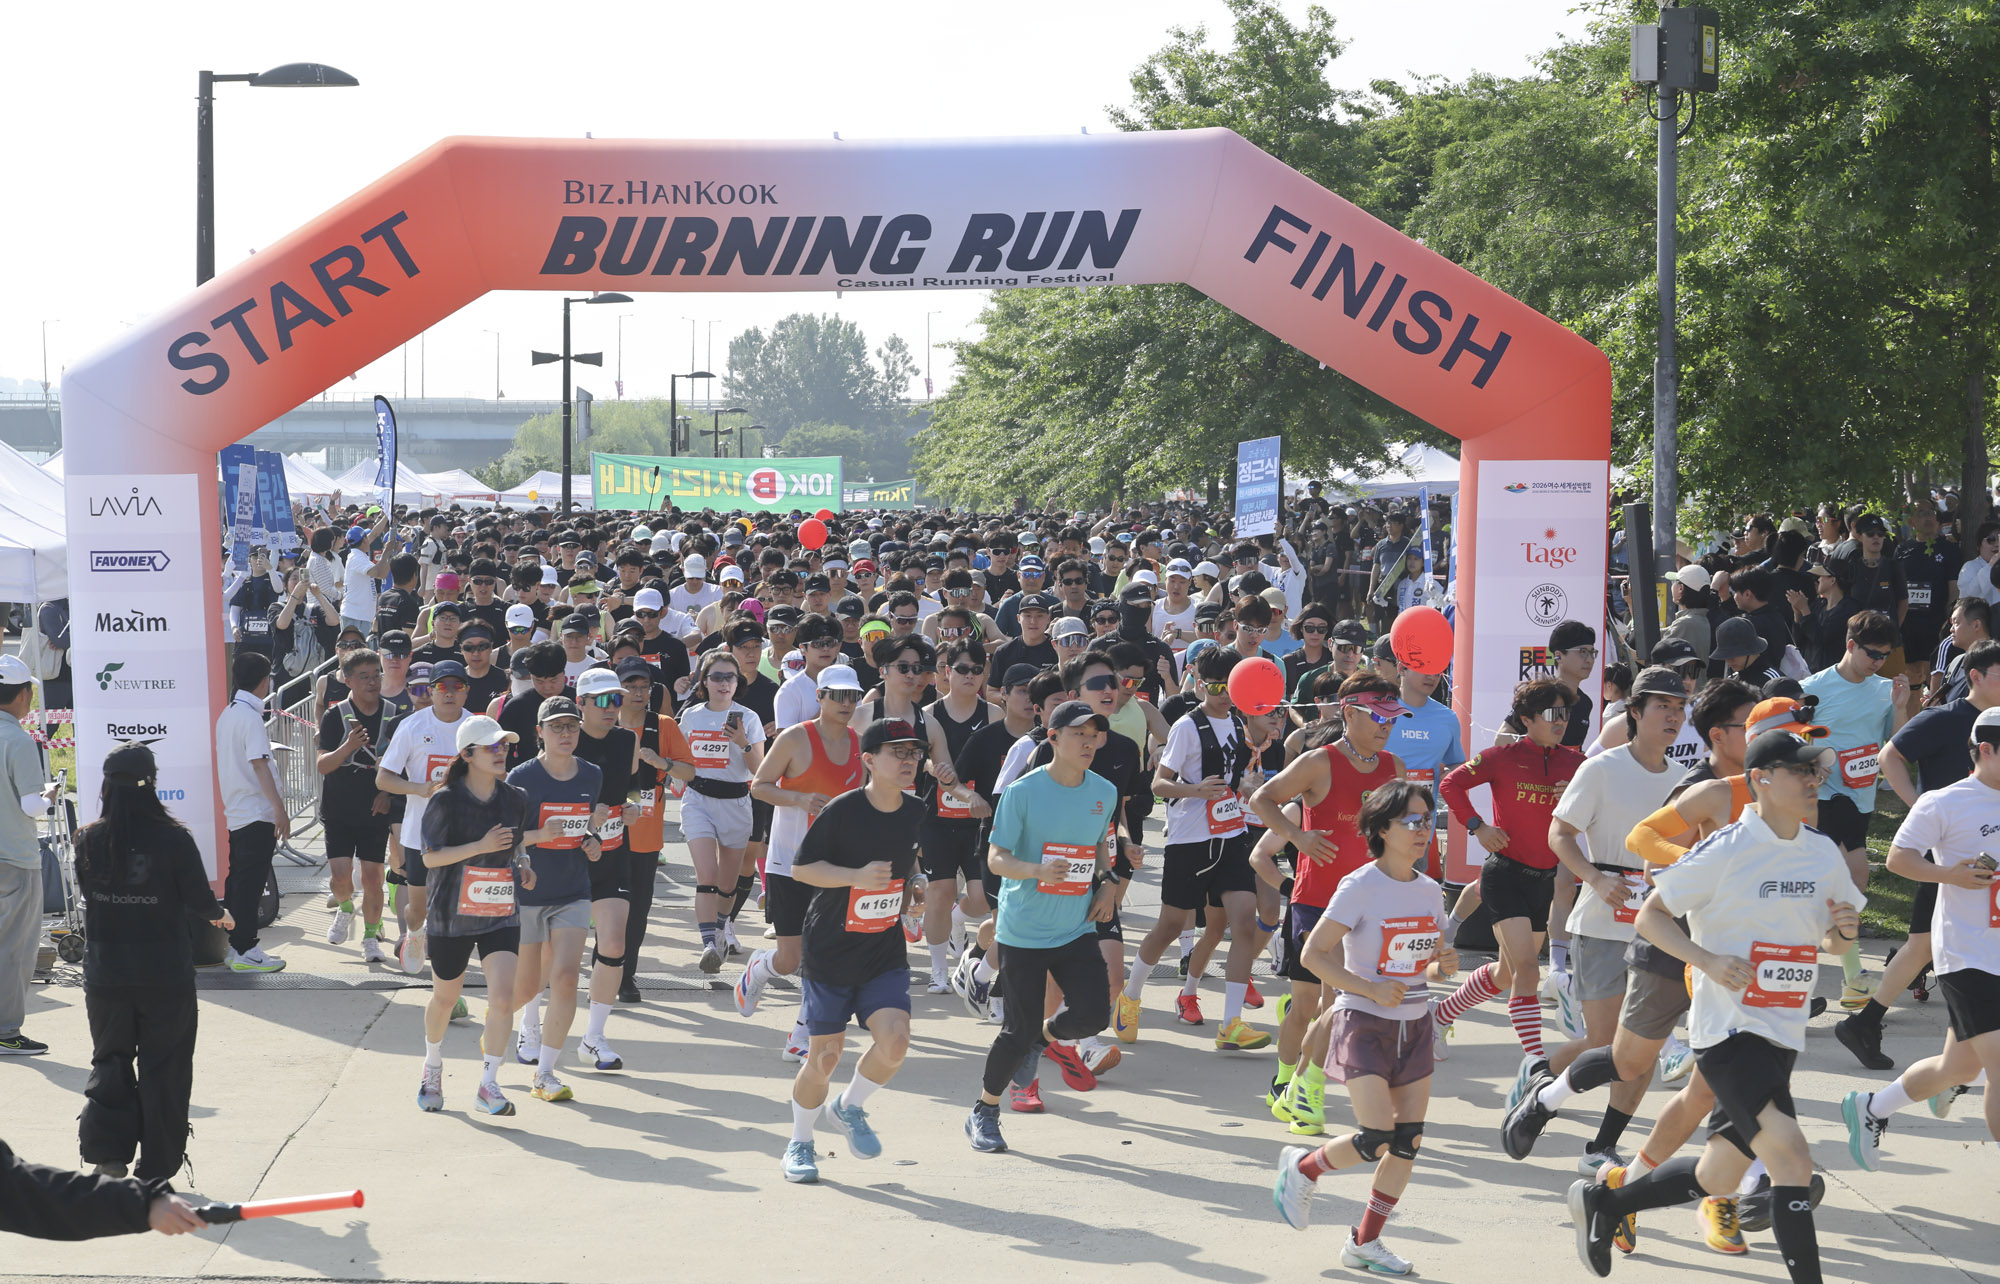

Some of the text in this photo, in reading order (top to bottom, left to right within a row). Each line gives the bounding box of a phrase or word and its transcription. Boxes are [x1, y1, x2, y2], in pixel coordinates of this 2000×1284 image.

[539, 208, 1142, 276] BURNING RUN
[837, 273, 1114, 288] Casual Running Festival
[167, 210, 421, 396] START
[1244, 204, 1512, 390] FINISH
[1239, 457, 1278, 484] 정근식
[1521, 542, 1577, 569] Tage
[95, 556, 157, 571] FAVONEX
[1531, 586, 1563, 599] SUNBODY
[95, 609, 168, 632] Maxim
[1534, 615, 1560, 625] TANNING
[1519, 665, 1557, 681] KIN
[114, 680, 175, 690] NEWTREE
[107, 723, 168, 737] Reebok
[1401, 730, 1429, 740] HDEX
[702, 744, 728, 753] 4297
[1665, 743, 1698, 758] RUN
[1216, 806, 1223, 814] M
[1068, 862, 1093, 874] 267
[473, 886, 512, 896] W 4588
[1781, 882, 1815, 893] HAPPS
[112, 893, 158, 904] balance
[861, 897, 900, 910] M 1611
[1395, 942, 1405, 951] W
[1763, 967, 1813, 982] M 2038
